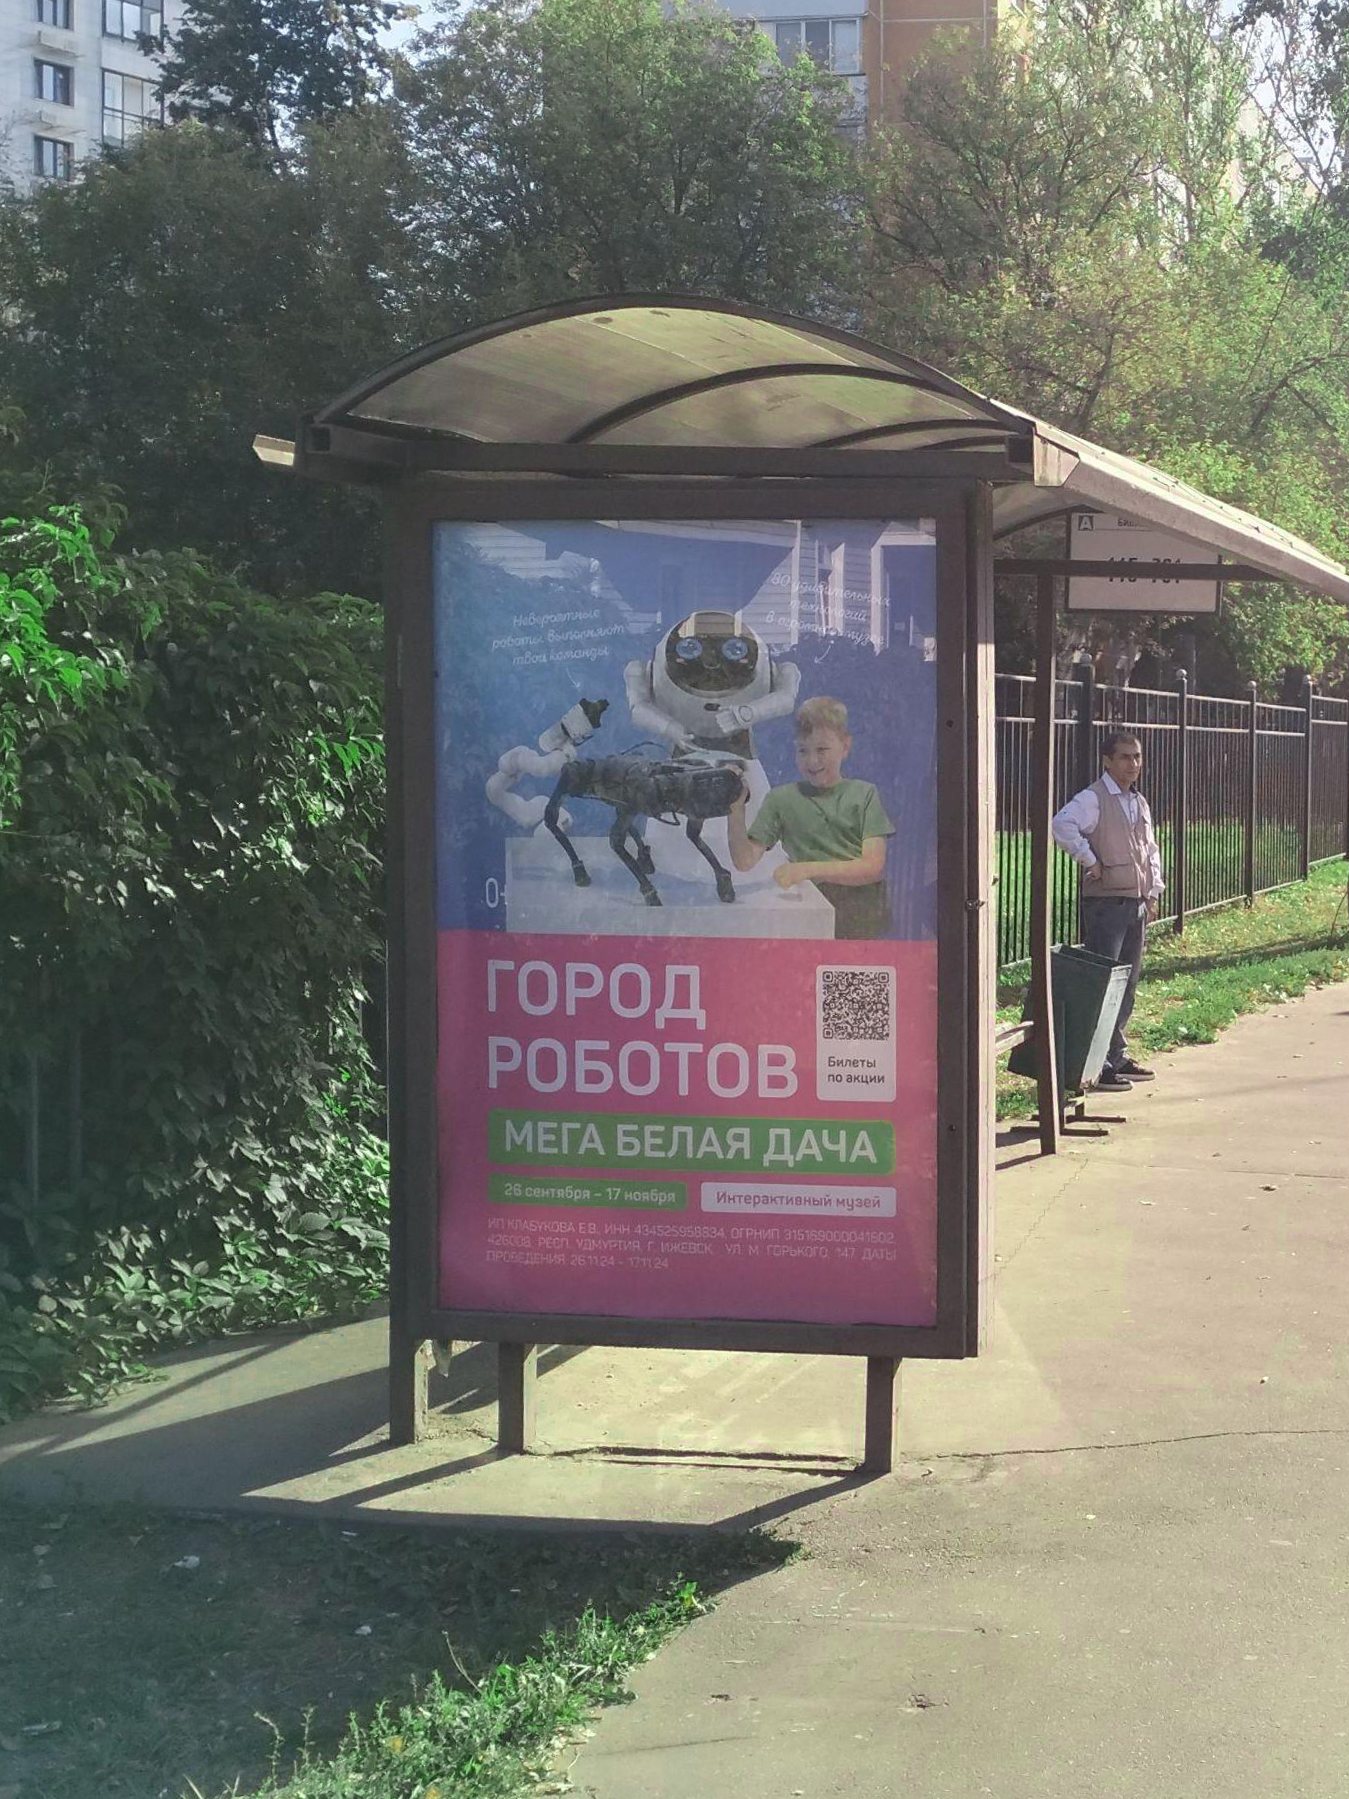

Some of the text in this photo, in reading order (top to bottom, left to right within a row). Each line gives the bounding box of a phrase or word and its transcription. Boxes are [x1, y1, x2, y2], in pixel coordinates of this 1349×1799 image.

[487, 959, 706, 1029] ГОРОД
[487, 1036, 798, 1099] РОБОТОВ
[827, 1055, 876, 1068] Билеты
[827, 1073, 885, 1085] по акции
[505, 1119, 877, 1168] МЕГА БЕЛАЯ ДАЧА
[504, 1183, 522, 1197] 26
[525, 1186, 591, 1201] сентября
[606, 1187, 621, 1200] 17
[624, 1189, 676, 1205] ноября
[716, 1191, 881, 1211] Интерактивный музей
[604, 1223, 630, 1235] ИНН
